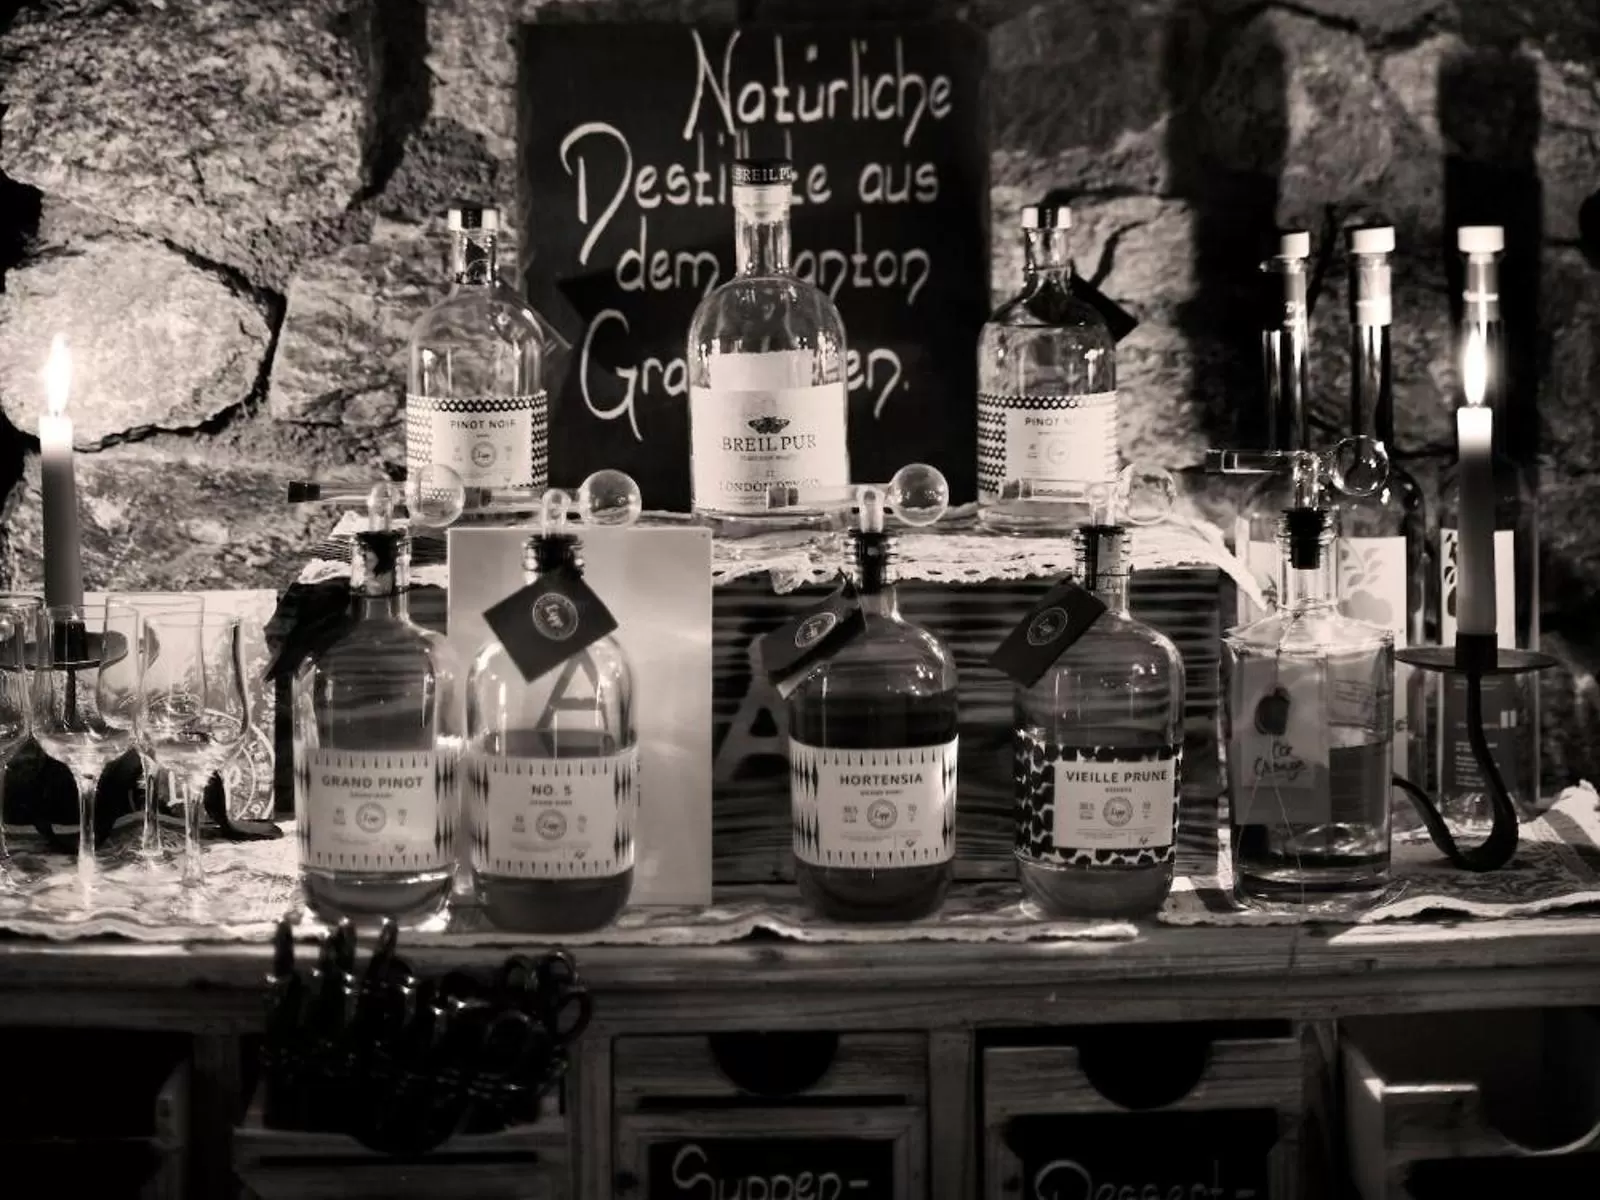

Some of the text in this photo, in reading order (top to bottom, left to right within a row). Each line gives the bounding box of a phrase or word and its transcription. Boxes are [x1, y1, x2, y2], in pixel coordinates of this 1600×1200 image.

[858, 162, 940, 204] aus
[615, 211, 931, 305] dem anton
[450, 419, 485, 430] PINOT
[721, 434, 817, 452] BREIL PUR
[321, 774, 424, 789] GRAND PINOT
[839, 772, 924, 786] HORTENSIA
[1066, 770, 1169, 784] VIEILLE PRUNE
[563, 784, 573, 797] 5
